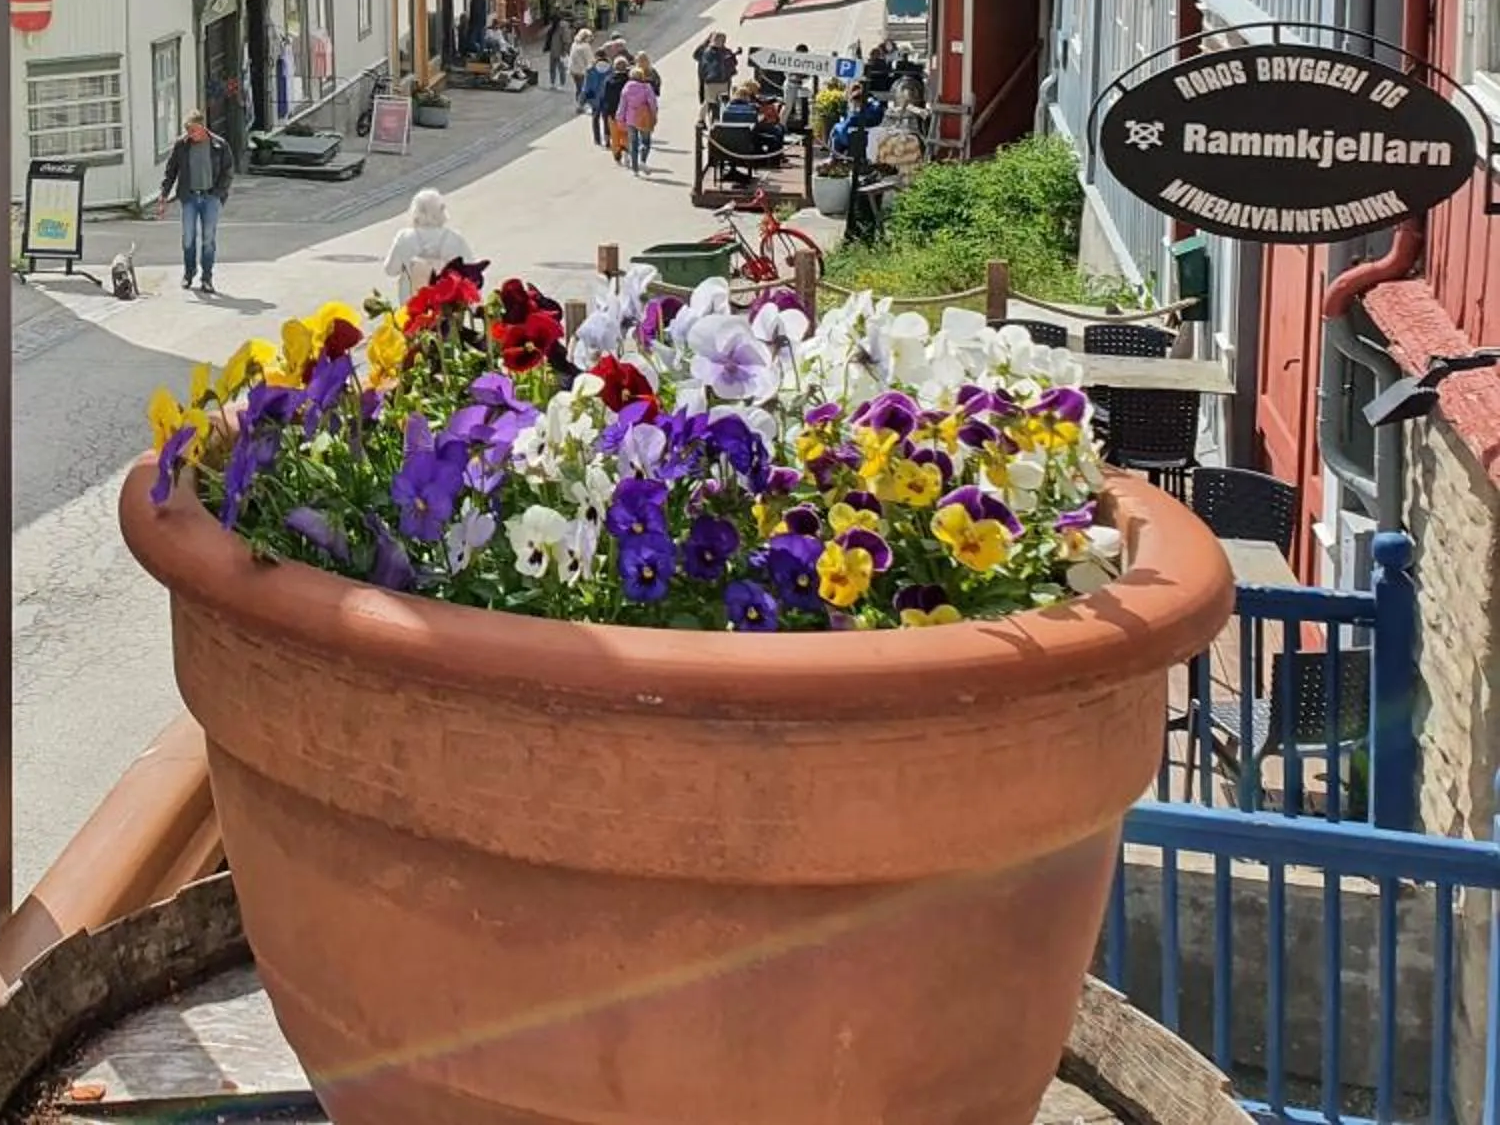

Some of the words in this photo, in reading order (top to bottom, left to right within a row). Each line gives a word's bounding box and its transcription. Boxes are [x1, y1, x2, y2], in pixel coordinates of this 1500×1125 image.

[767, 53, 830, 73] Automat
[1256, 56, 1369, 94] BRYGGERI
[1369, 79, 1410, 109] OG
[1183, 123, 1452, 168] Rammkjellarn
[1159, 178, 1409, 233] MINERALVANNFABRIKK
